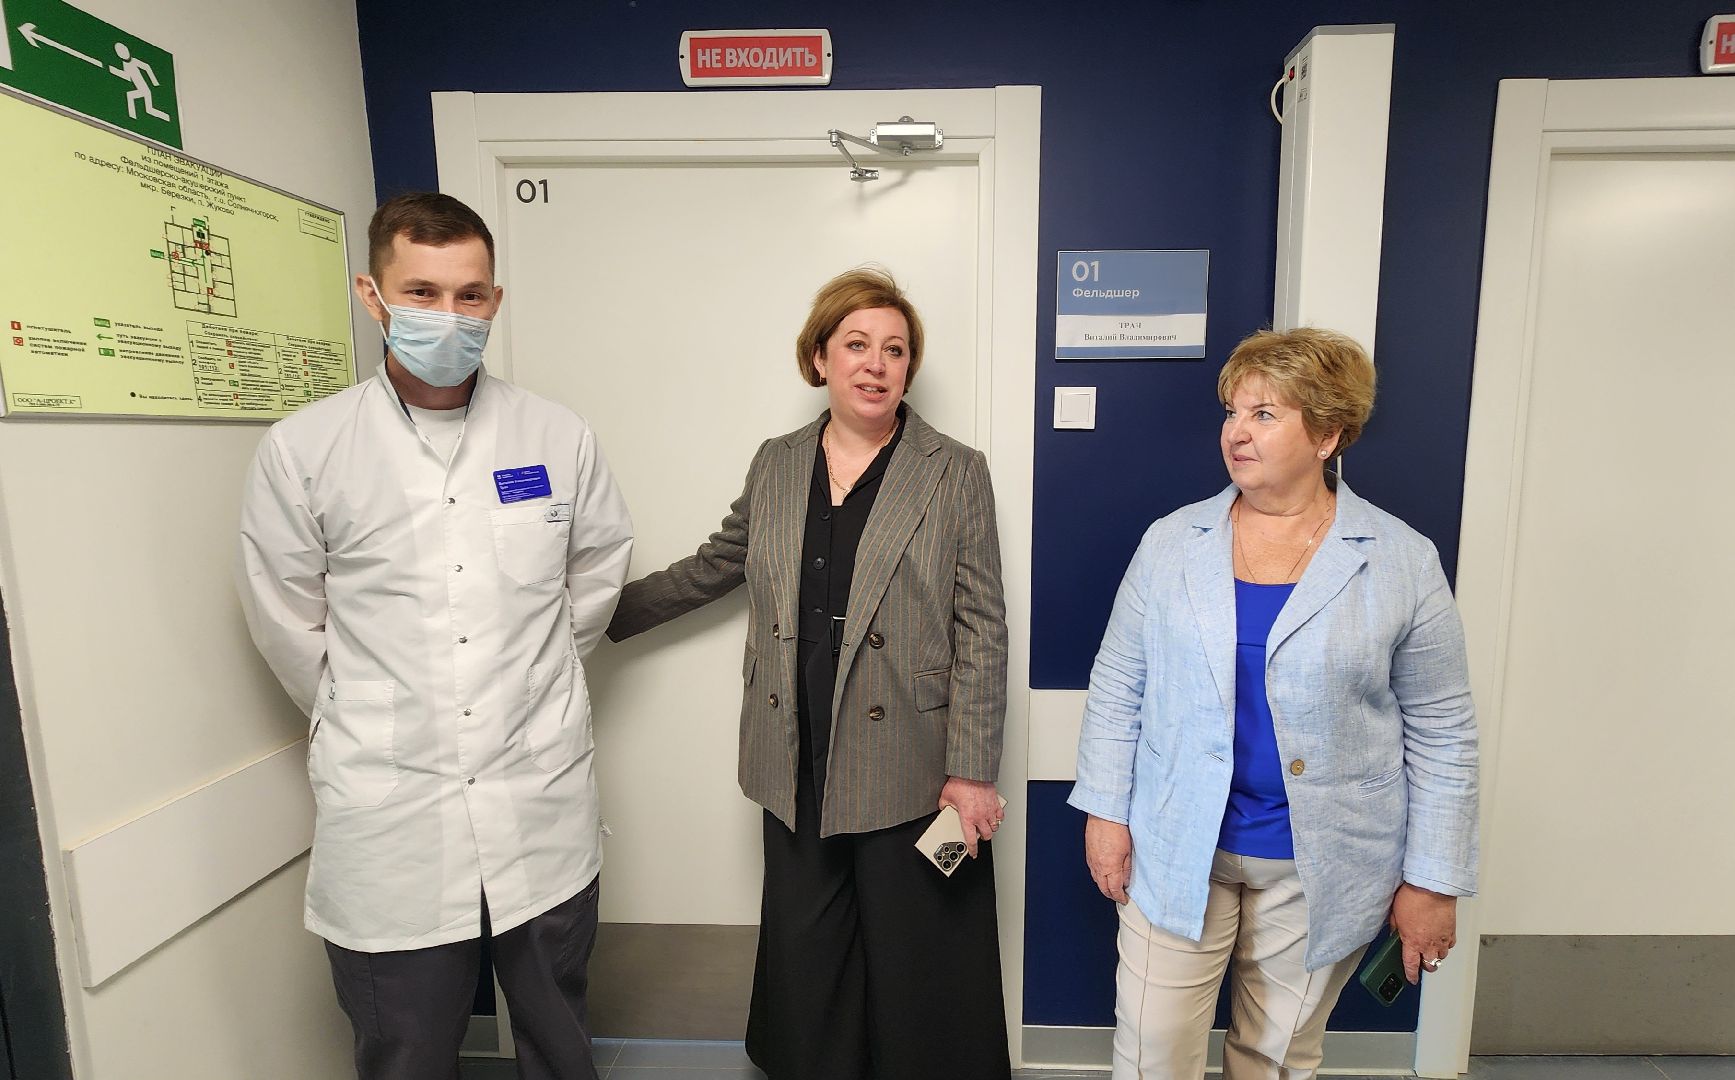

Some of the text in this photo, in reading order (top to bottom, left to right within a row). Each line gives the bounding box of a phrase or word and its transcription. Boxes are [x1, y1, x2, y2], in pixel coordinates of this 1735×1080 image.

[698, 47, 817, 70] НЕ ВХОДИТЬ
[74, 152, 86, 160] по
[89, 156, 124, 173] адресу:
[126, 166, 176, 188] Московская
[141, 154, 152, 163] из
[153, 159, 198, 179] помещений
[206, 177, 230, 189] этажа
[140, 182, 160, 192] мкр.
[516, 179, 548, 204] 01
[1072, 260, 1100, 282] 01
[1072, 288, 1140, 299] Фельдшер
[1120, 333, 1177, 342] Владимирович
